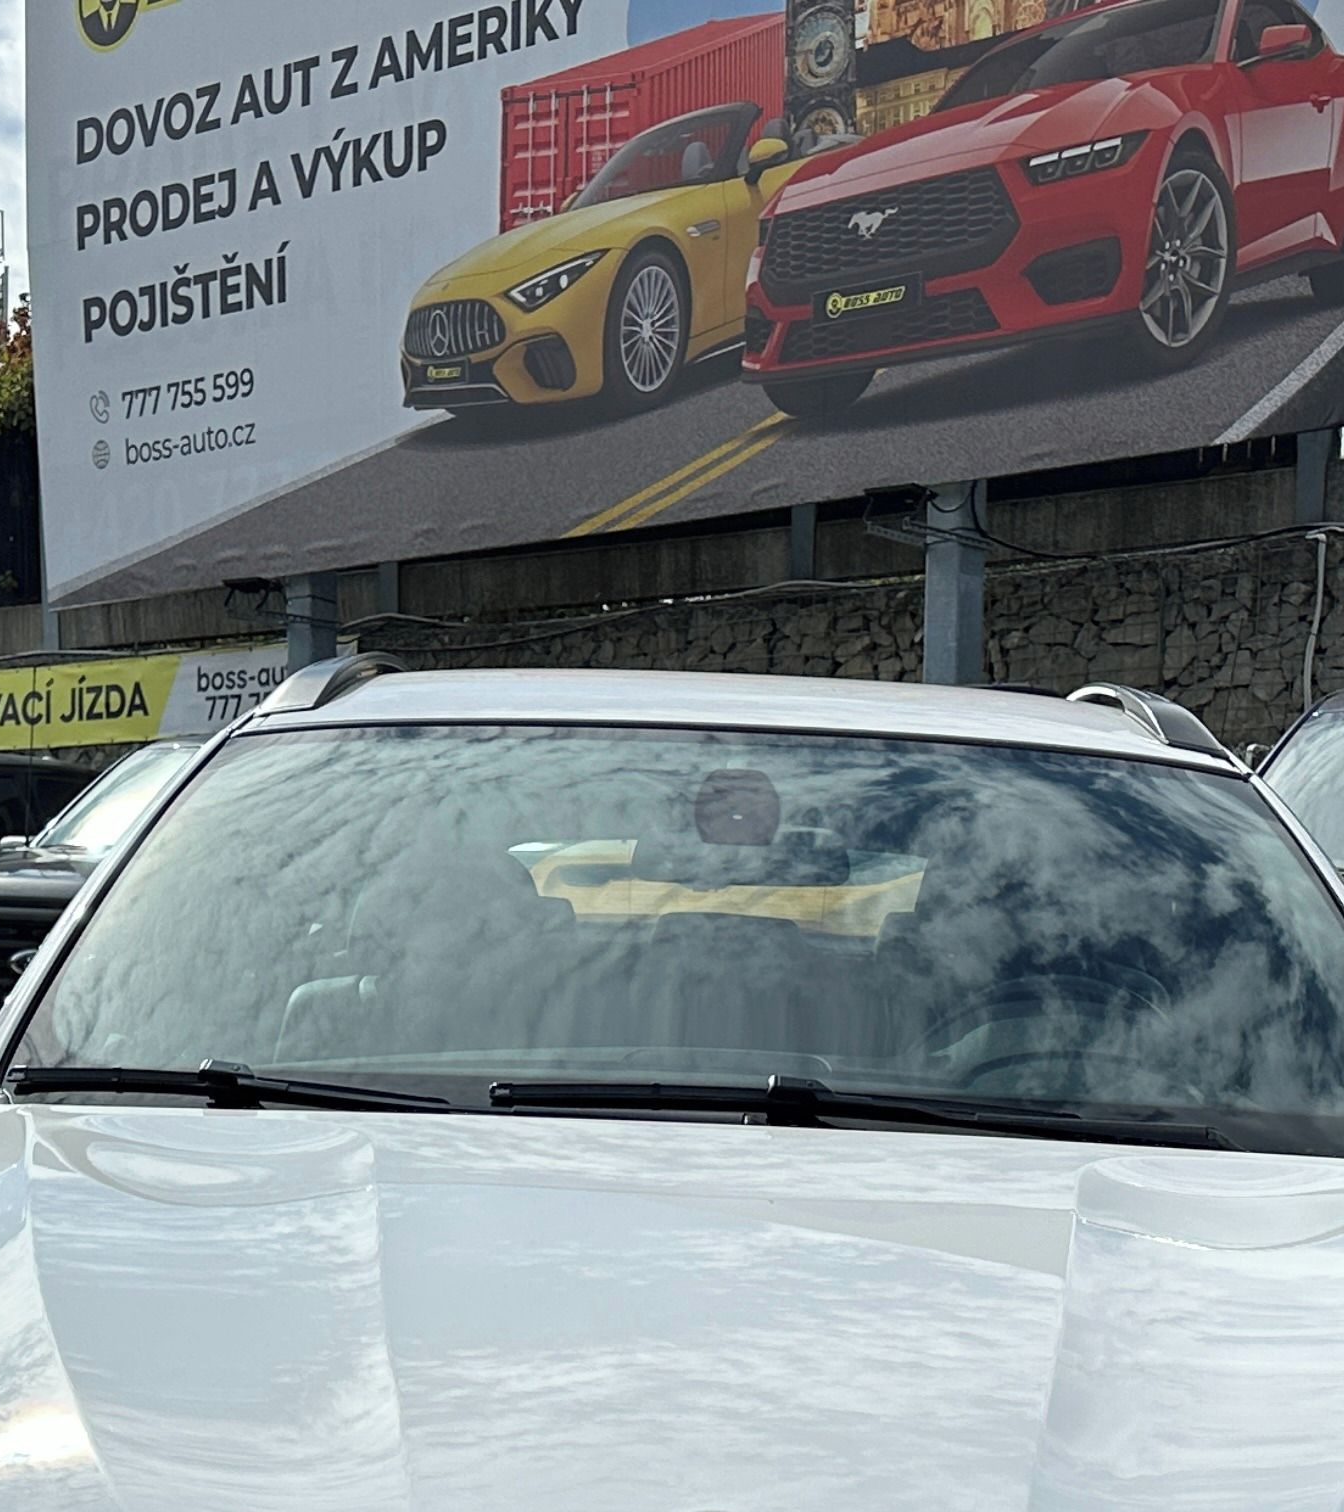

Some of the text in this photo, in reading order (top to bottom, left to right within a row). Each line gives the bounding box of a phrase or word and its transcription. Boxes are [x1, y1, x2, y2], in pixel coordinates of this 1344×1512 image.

[76, 0, 582, 165] DOVOZ AUT Z AMERIKY
[77, 119, 447, 251] PRODEJ A VÝKUP
[82, 240, 290, 343] POJIŠTĚNÍ
[121, 368, 254, 419] 777 755 599
[125, 423, 256, 465] boss-auto.cz
[59, 675, 149, 723] JÍZDA
[197, 665, 288, 692] boss-au
[205, 694, 242, 721] 777
